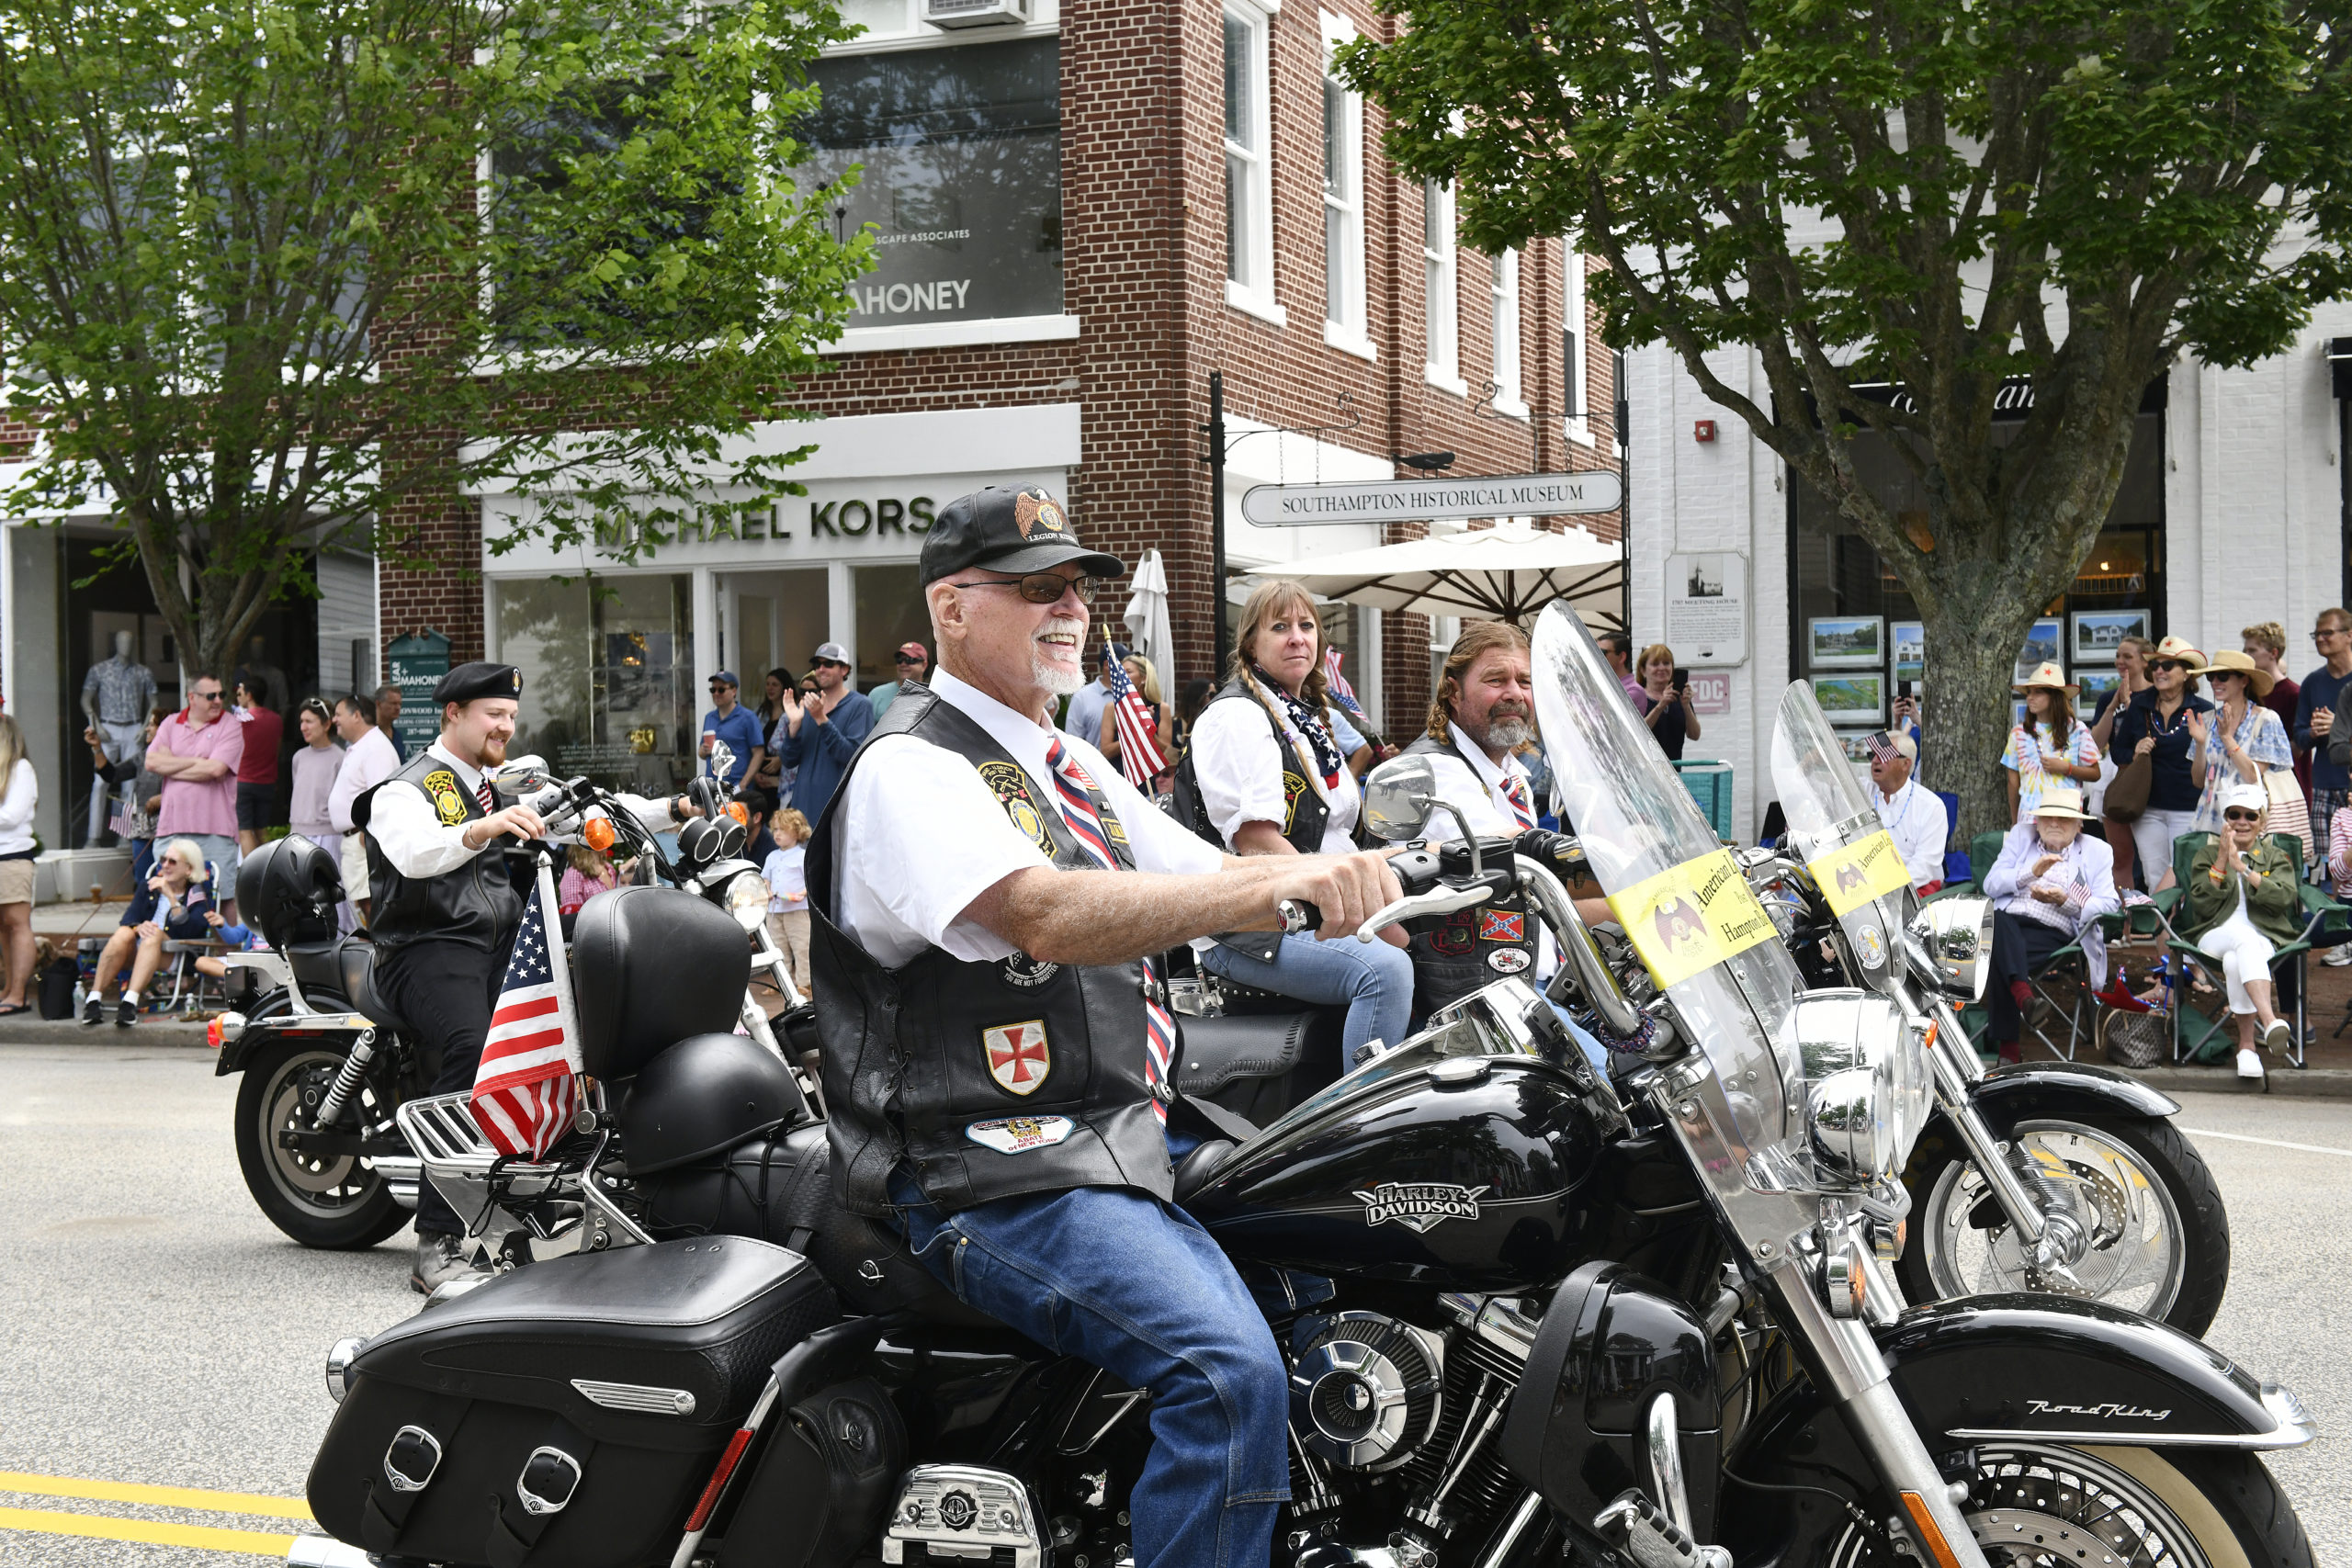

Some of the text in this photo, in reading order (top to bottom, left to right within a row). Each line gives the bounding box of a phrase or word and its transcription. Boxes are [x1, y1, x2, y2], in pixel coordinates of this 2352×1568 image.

[876, 229, 971, 245] SCAPE ASSOCIATES
[847, 278, 971, 316] AHONEY
[1282, 483, 1584, 513] SOUTHAMPTON HISTORICAL MUSEUM
[809, 495, 936, 538] KORS
[1029, 532, 1058, 542] LEGION
[400, 674, 447, 686] MAHONE
[1858, 840, 1883, 873] American
[1691, 864, 1732, 915] American
[1721, 918, 1762, 942] Hampton
[1004, 964, 1059, 987] YOU ARE NOT FORGOTTEN
[1017, 1140, 1036, 1148] NEW
[1368, 1200, 1476, 1224] DAVIDSON
